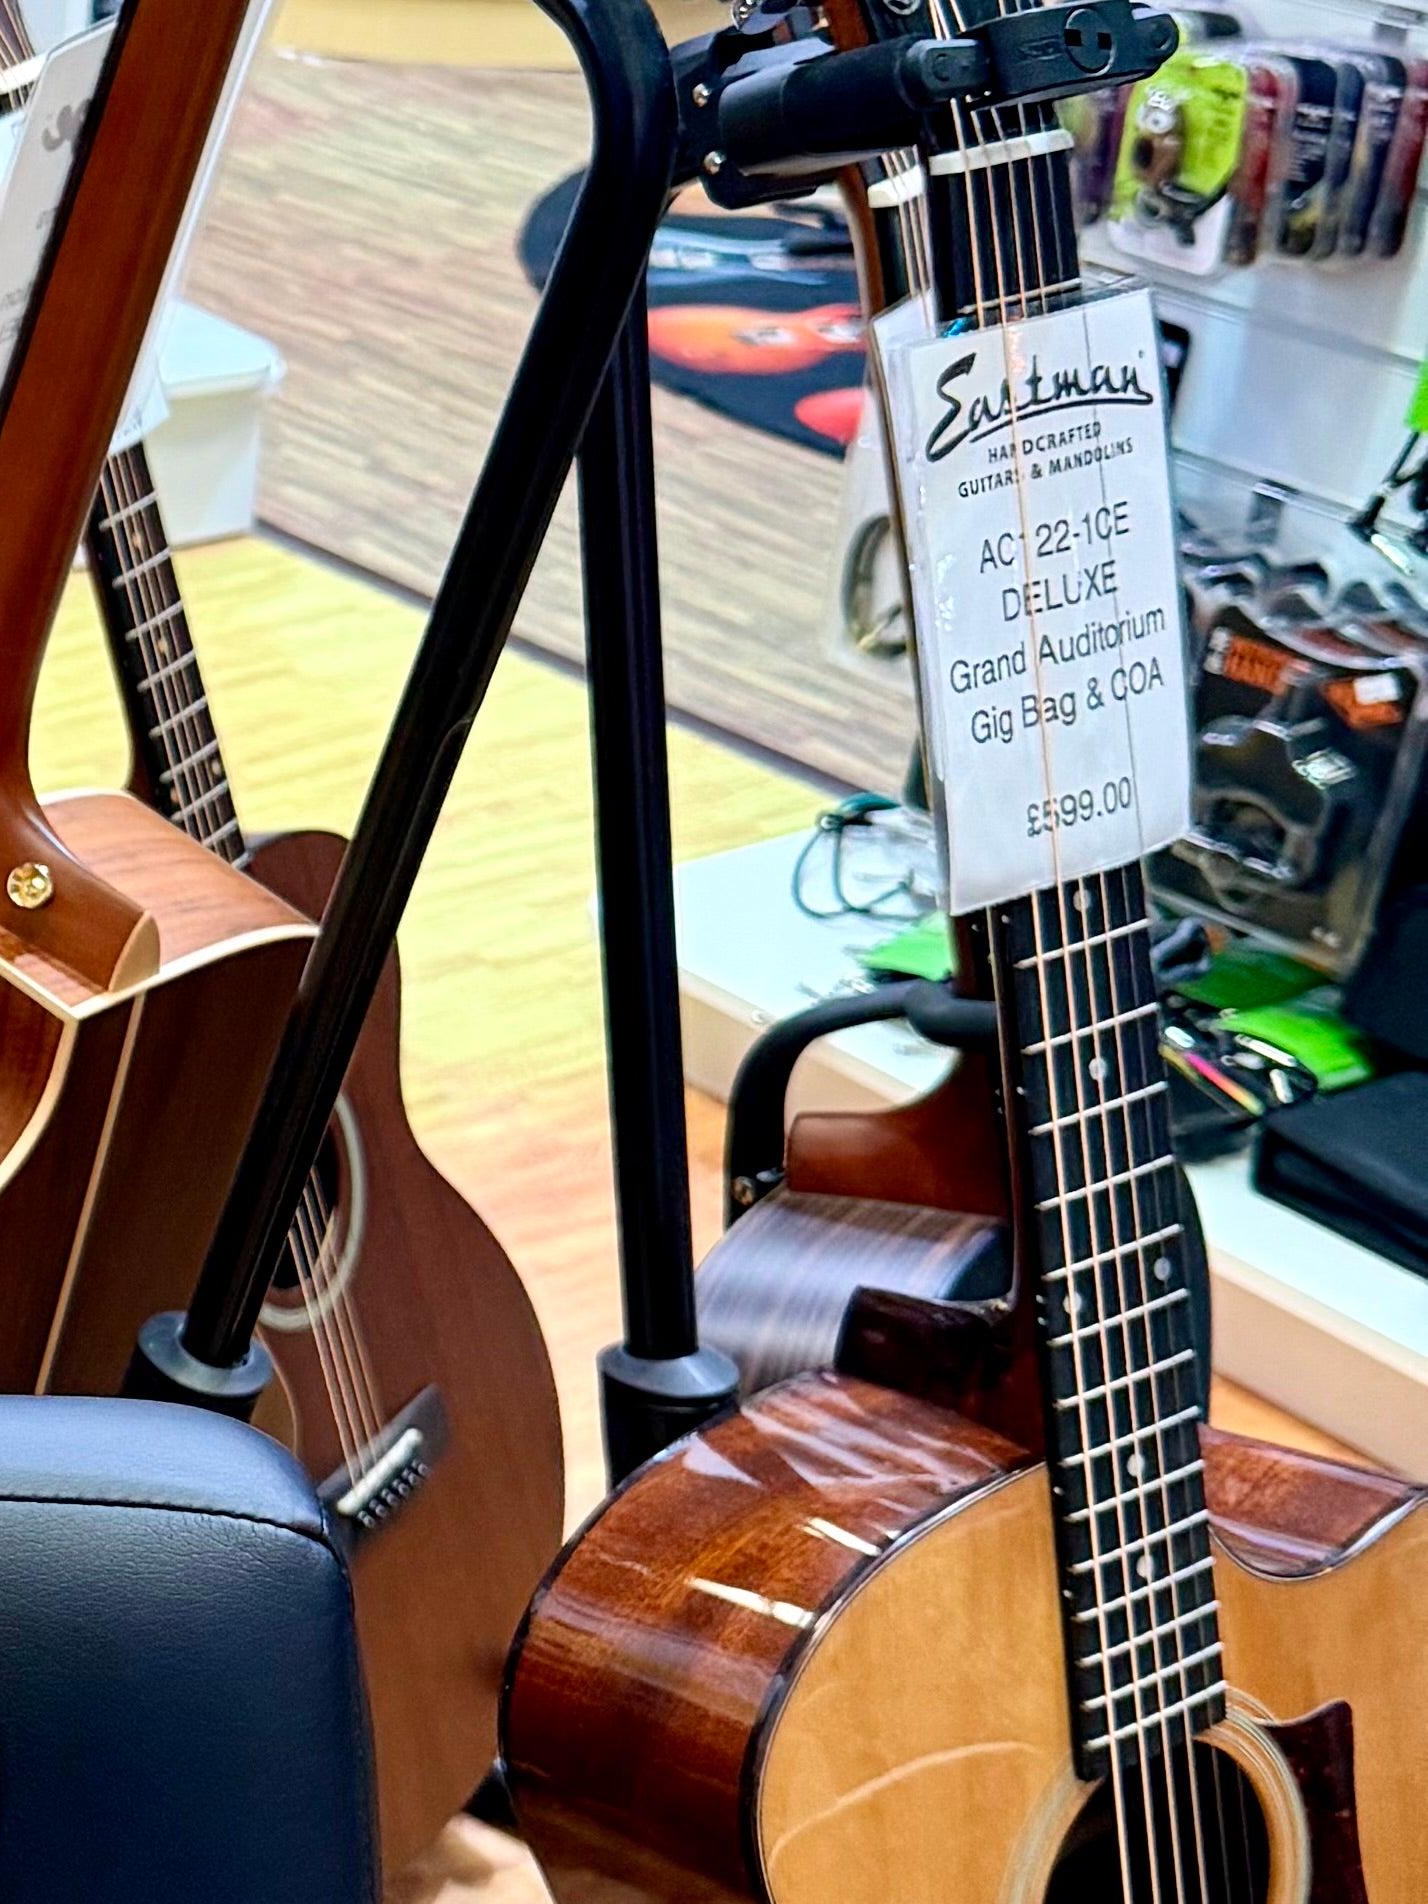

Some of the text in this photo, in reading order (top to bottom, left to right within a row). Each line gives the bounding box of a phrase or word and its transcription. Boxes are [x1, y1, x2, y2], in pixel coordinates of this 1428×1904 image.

[926, 350, 1153, 462] Eastman
[1031, 461, 1043, 480] &
[1047, 437, 1134, 478] MANDOLINS
[1001, 560, 1117, 622] DELUXE
[949, 604, 1165, 694] Grand Auditorium
[971, 659, 1164, 745] Gig Bag & COA
[1025, 775, 1131, 838] £599.00
